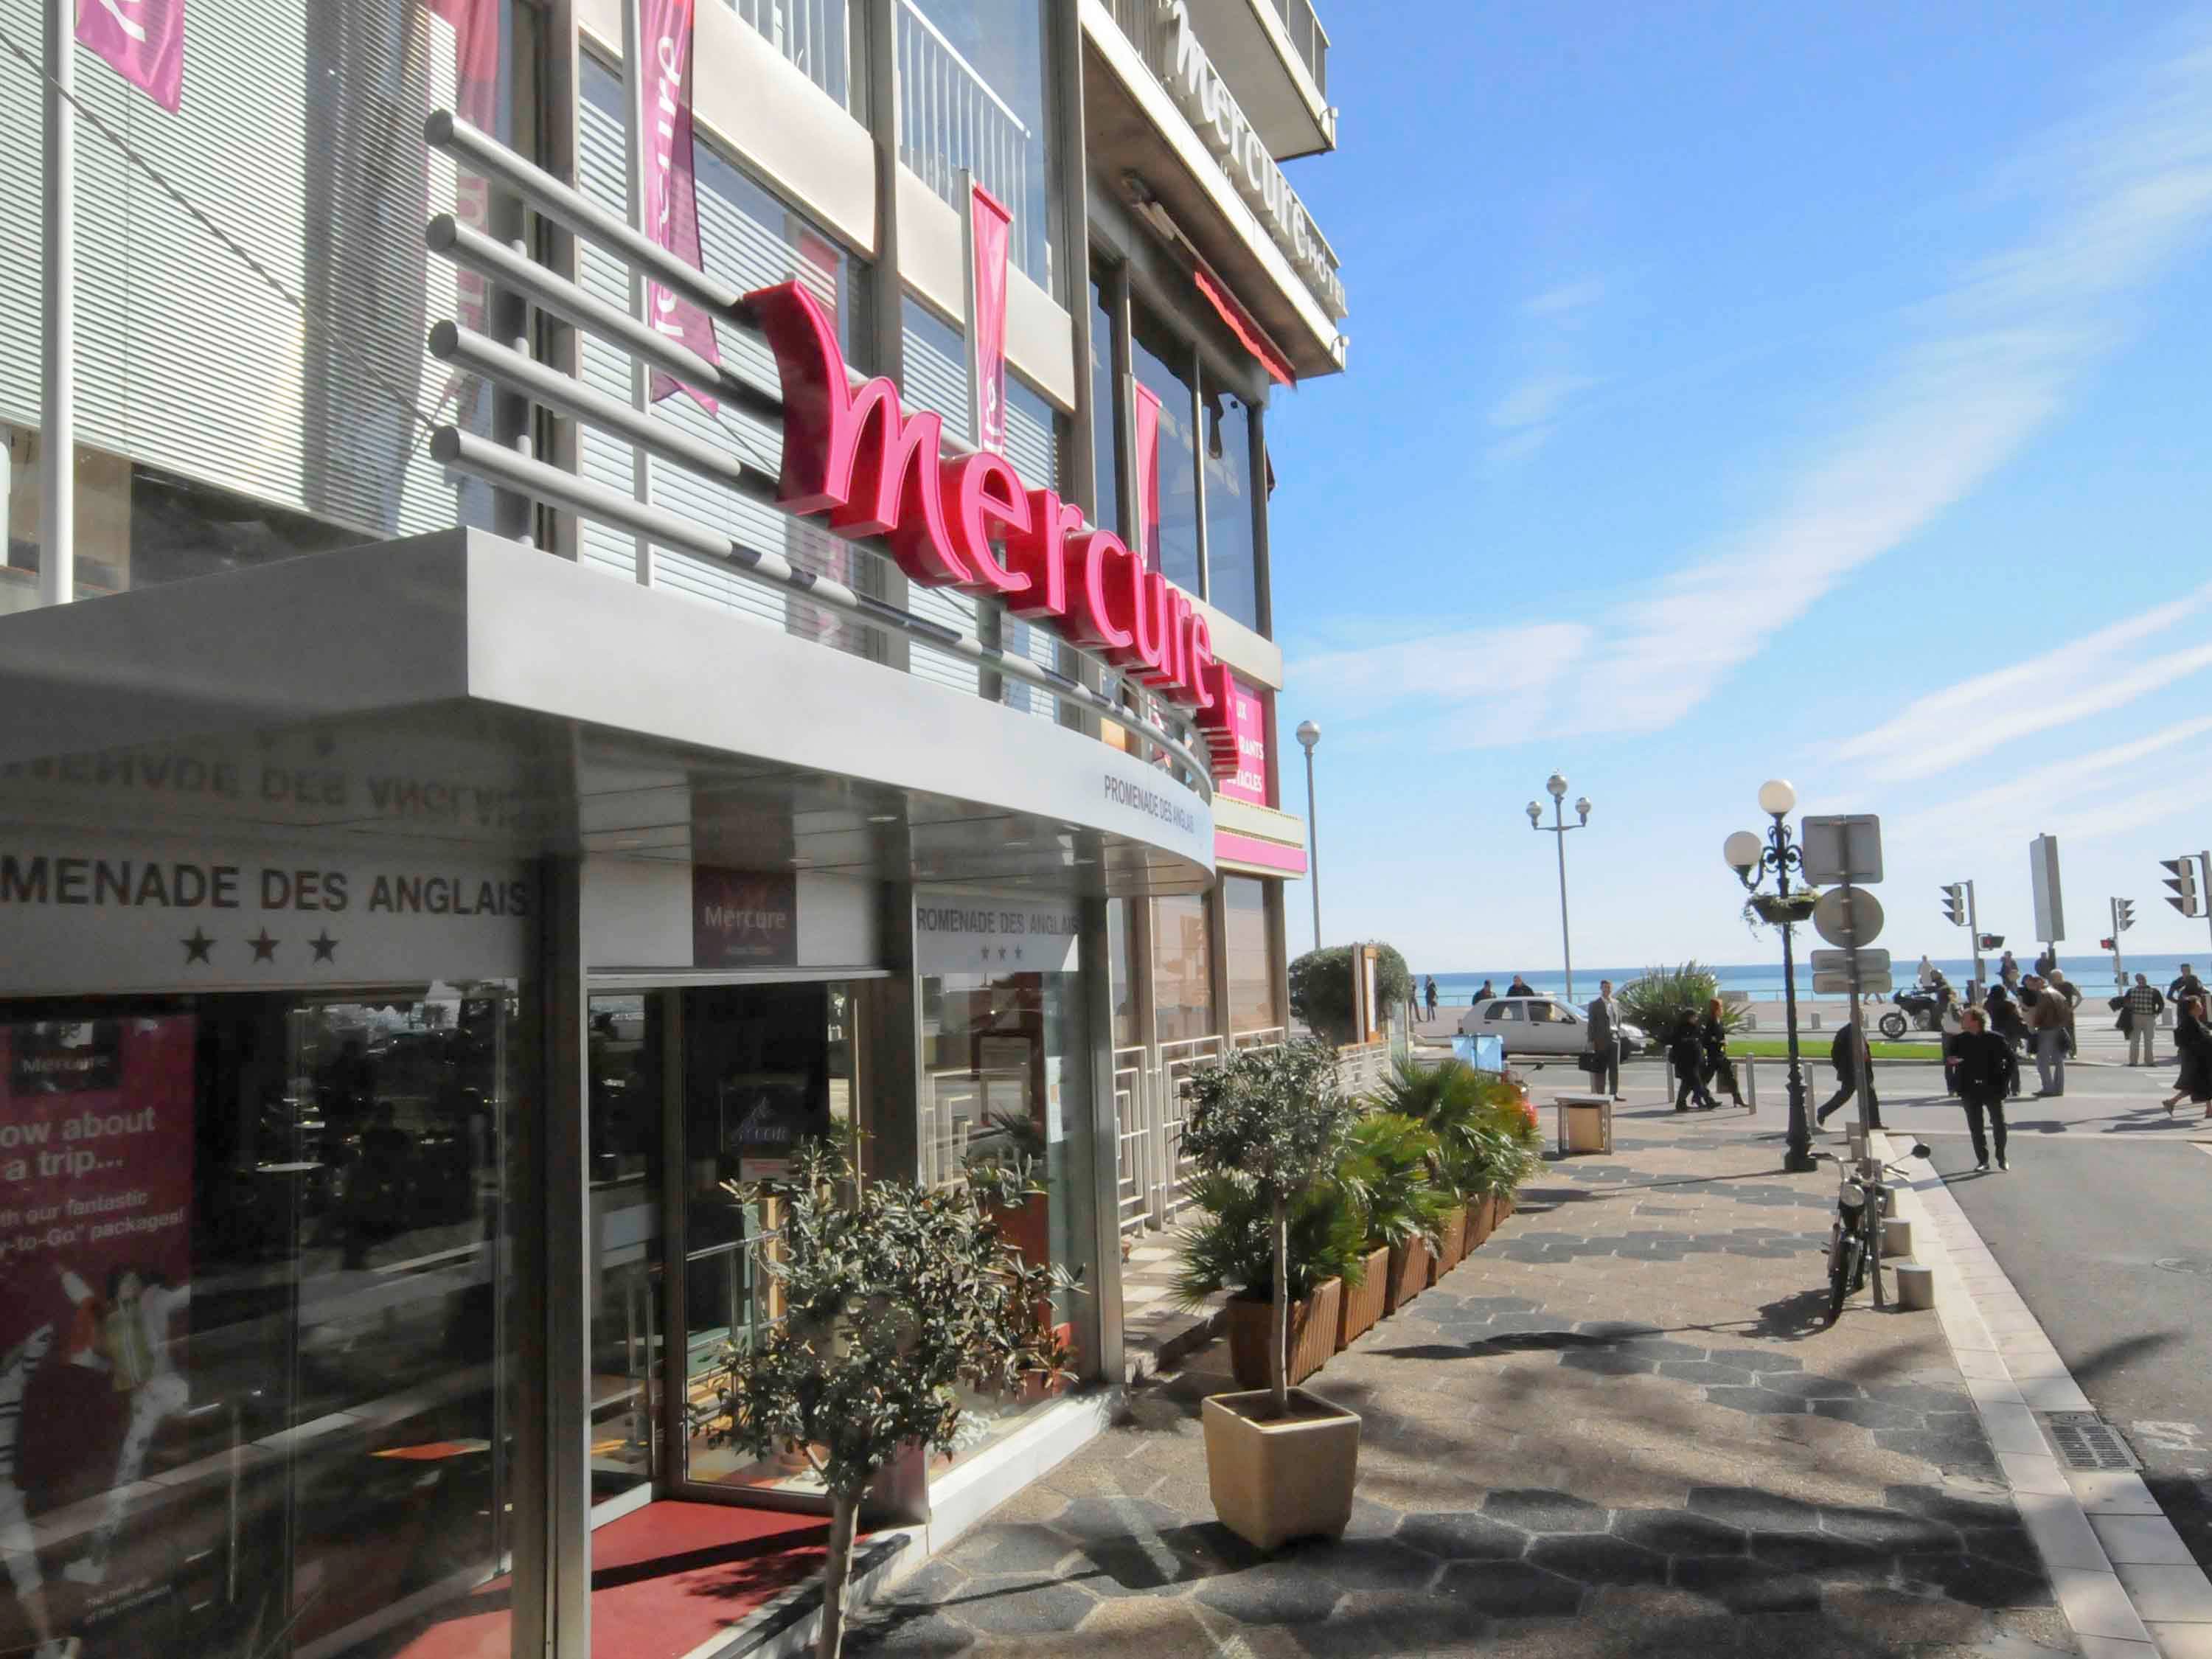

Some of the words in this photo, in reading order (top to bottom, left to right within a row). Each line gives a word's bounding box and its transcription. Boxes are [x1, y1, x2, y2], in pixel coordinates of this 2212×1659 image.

[1172, 0, 1306, 259] Mercure
[742, 278, 1214, 709] Mercure
[1104, 774, 1159, 817] PROMENADE
[1159, 798, 1172, 823] DES
[261, 867, 348, 913] DES
[369, 874, 528, 917] ANGLAIS
[704, 905, 786, 929] Mercure
[917, 908, 995, 933] ROMENADE
[1000, 913, 1026, 934] DES
[63, 1106, 156, 1141] about
[5, 1157, 27, 1181] a
[38, 1145, 124, 1180] trip...
[27, 1204, 60, 1222] our
[66, 1189, 148, 1217] fantastic
[89, 1206, 184, 1242] packages!
